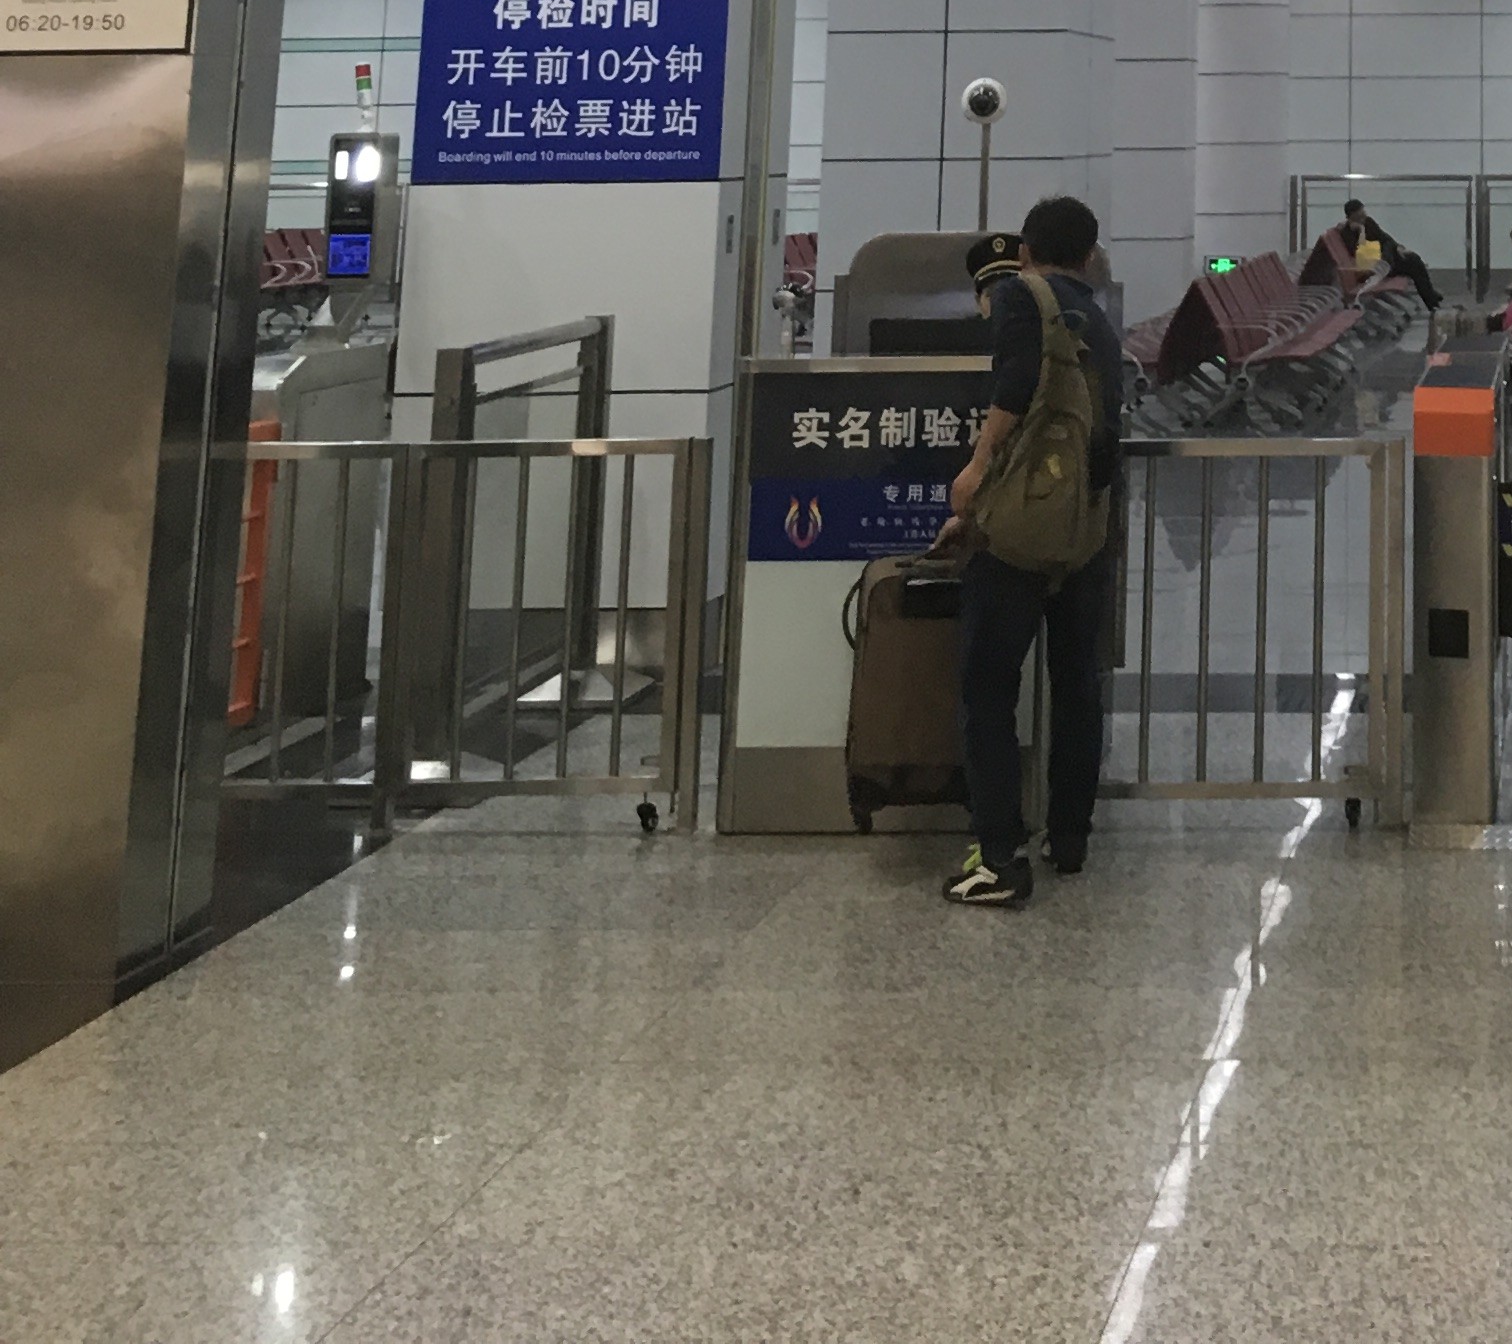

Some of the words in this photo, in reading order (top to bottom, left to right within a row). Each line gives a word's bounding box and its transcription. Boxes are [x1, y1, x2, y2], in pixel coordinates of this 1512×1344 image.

[5, 13, 125, 32] 06:20-19:50
[447, 43, 702, 86] 开车前10分钟
[442, 97, 701, 139] 停止检票进站
[438, 151, 491, 164] Boarding
[493, 151, 513, 162] will
[515, 151, 537, 162] end
[541, 150, 554, 161] 10
[556, 150, 602, 161] minutes
[604, 149, 641, 161] before
[644, 149, 700, 160] departure
[883, 484, 947, 503] 专用通
